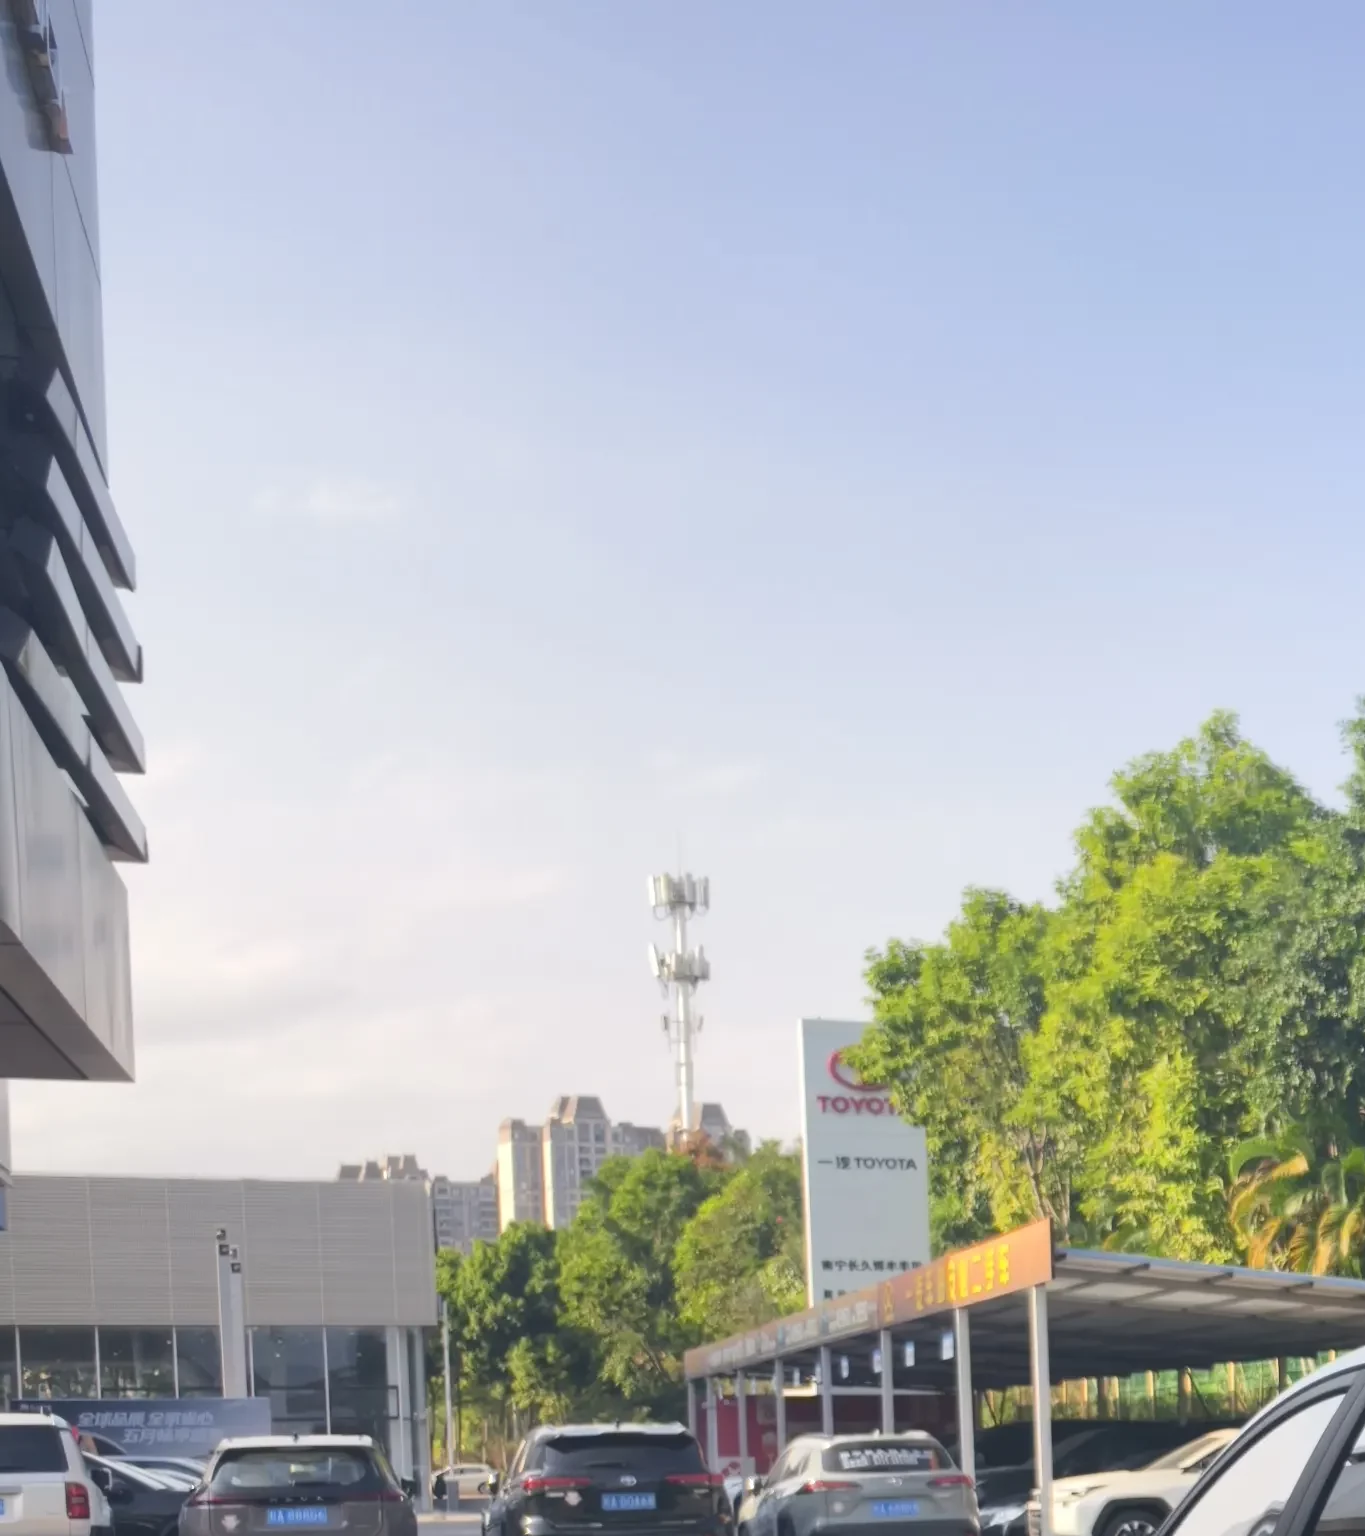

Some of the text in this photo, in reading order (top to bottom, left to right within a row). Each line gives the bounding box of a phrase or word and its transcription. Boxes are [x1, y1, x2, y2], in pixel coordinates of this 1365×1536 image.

[816, 1096, 904, 1116] TOYOT
[817, 1156, 918, 1171] 一汽 TOYOTA
